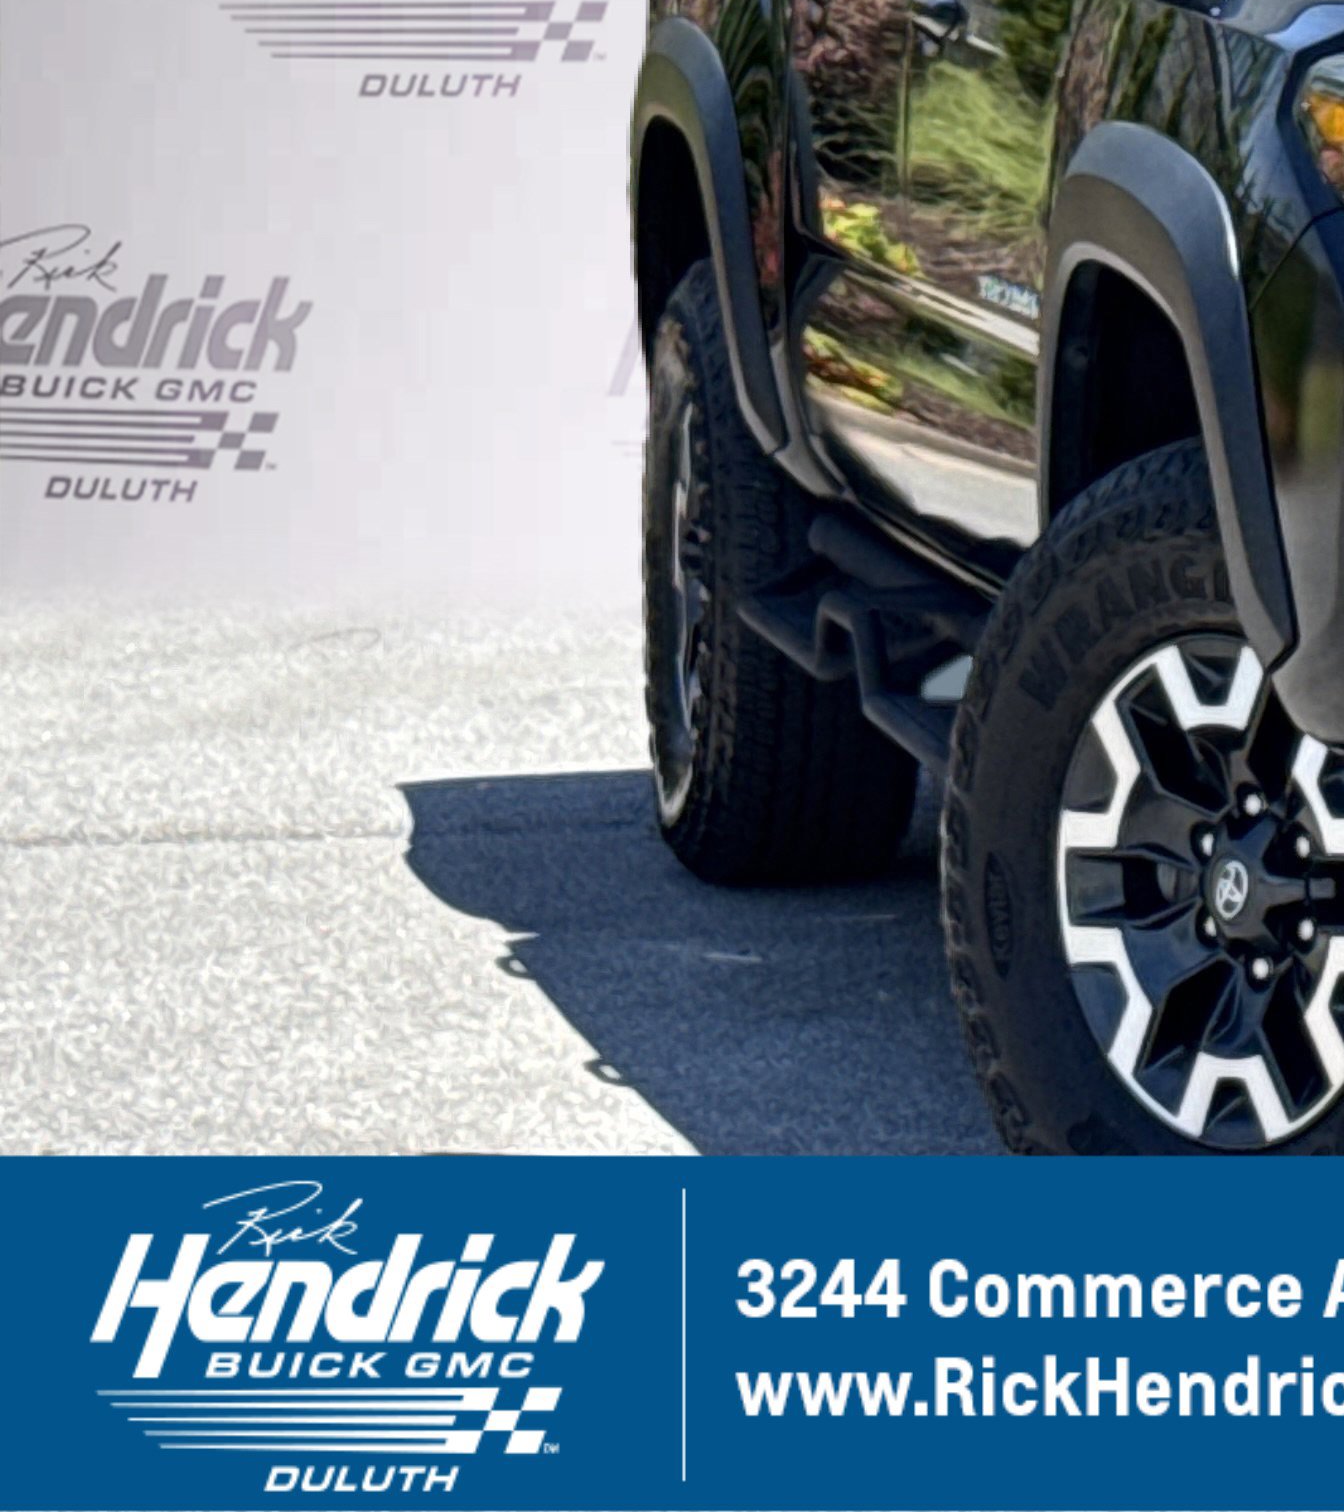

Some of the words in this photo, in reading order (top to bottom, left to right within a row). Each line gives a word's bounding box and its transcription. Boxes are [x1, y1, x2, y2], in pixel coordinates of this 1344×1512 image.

[358, 73, 521, 98] DULUTH
[0, 274, 313, 372] endrick
[0, 375, 139, 400] BUICK
[155, 379, 257, 403] GMC
[45, 477, 198, 502] DULUTH
